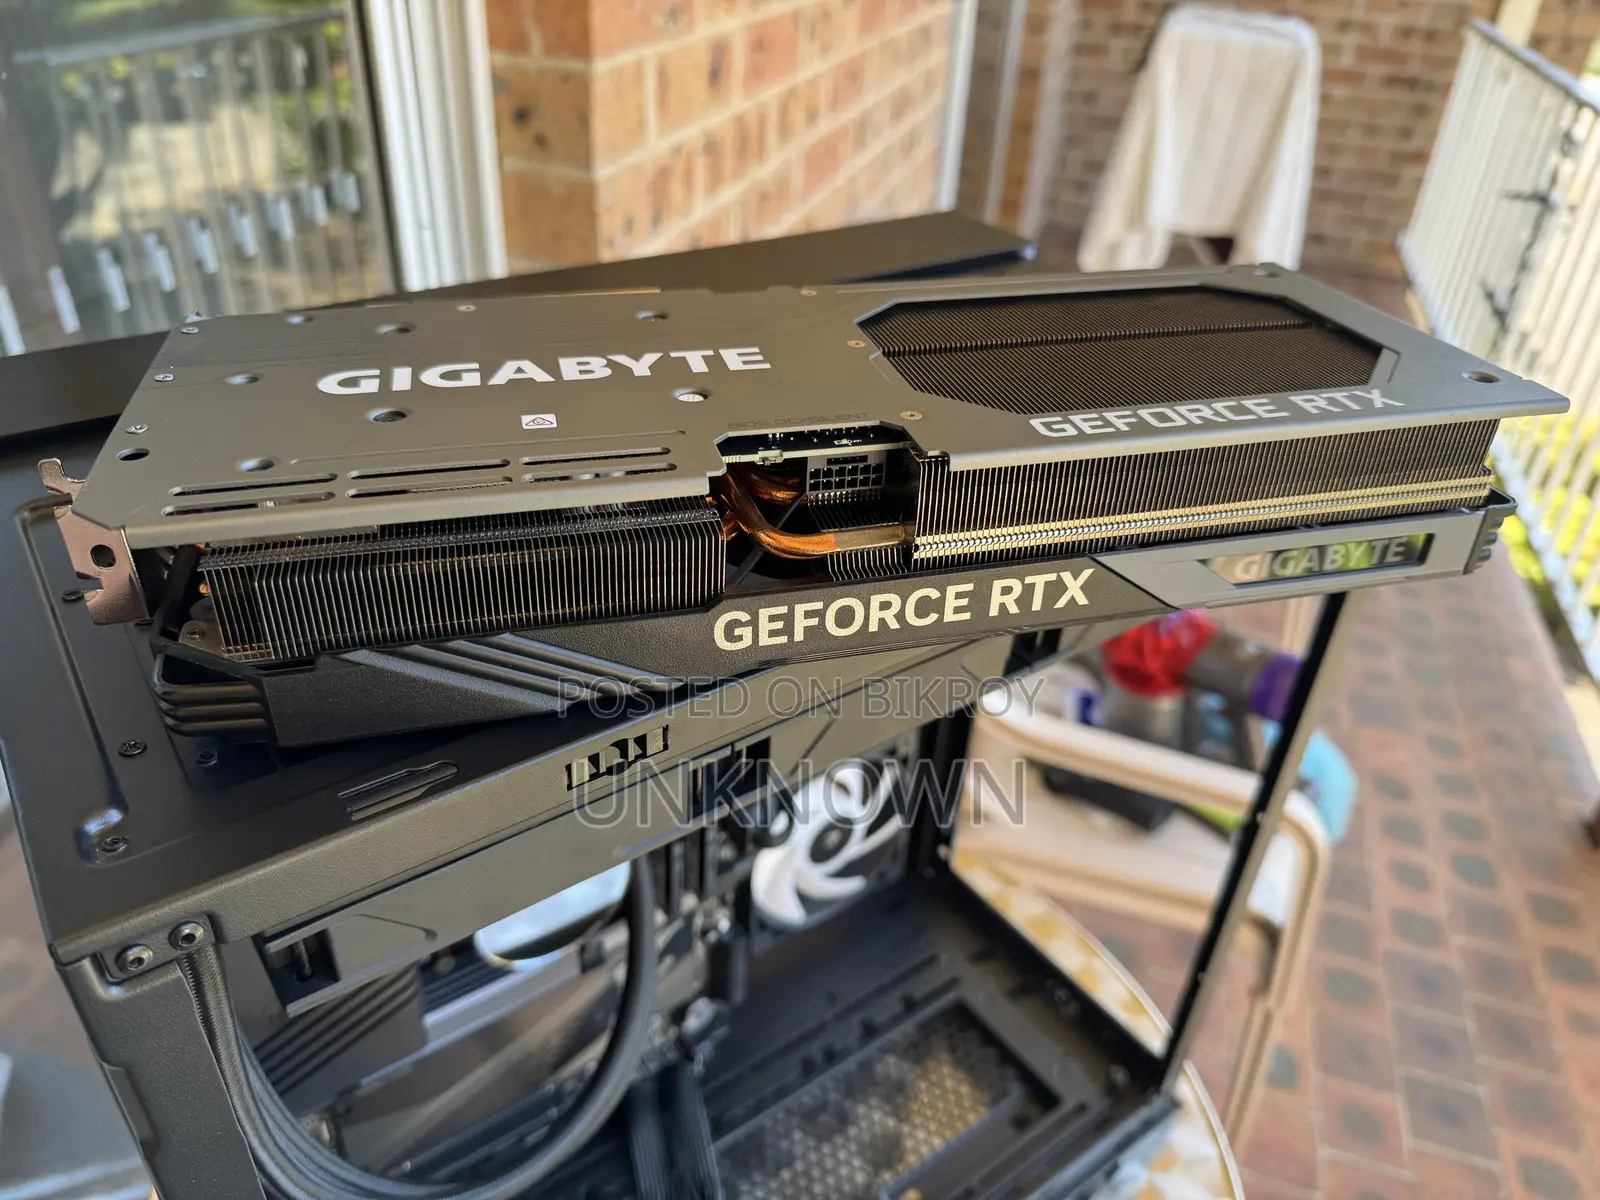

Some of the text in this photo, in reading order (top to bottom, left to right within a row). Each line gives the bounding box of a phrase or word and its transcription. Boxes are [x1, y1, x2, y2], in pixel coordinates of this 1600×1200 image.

[316, 347, 771, 396] GIGABYTE
[726, 412, 870, 429] BIOS OC/SILENT
[1029, 388, 1405, 438] GEFORCE RTX
[1233, 537, 1409, 580] GIGABYTE
[713, 568, 1096, 652] GEFORCE RTX
